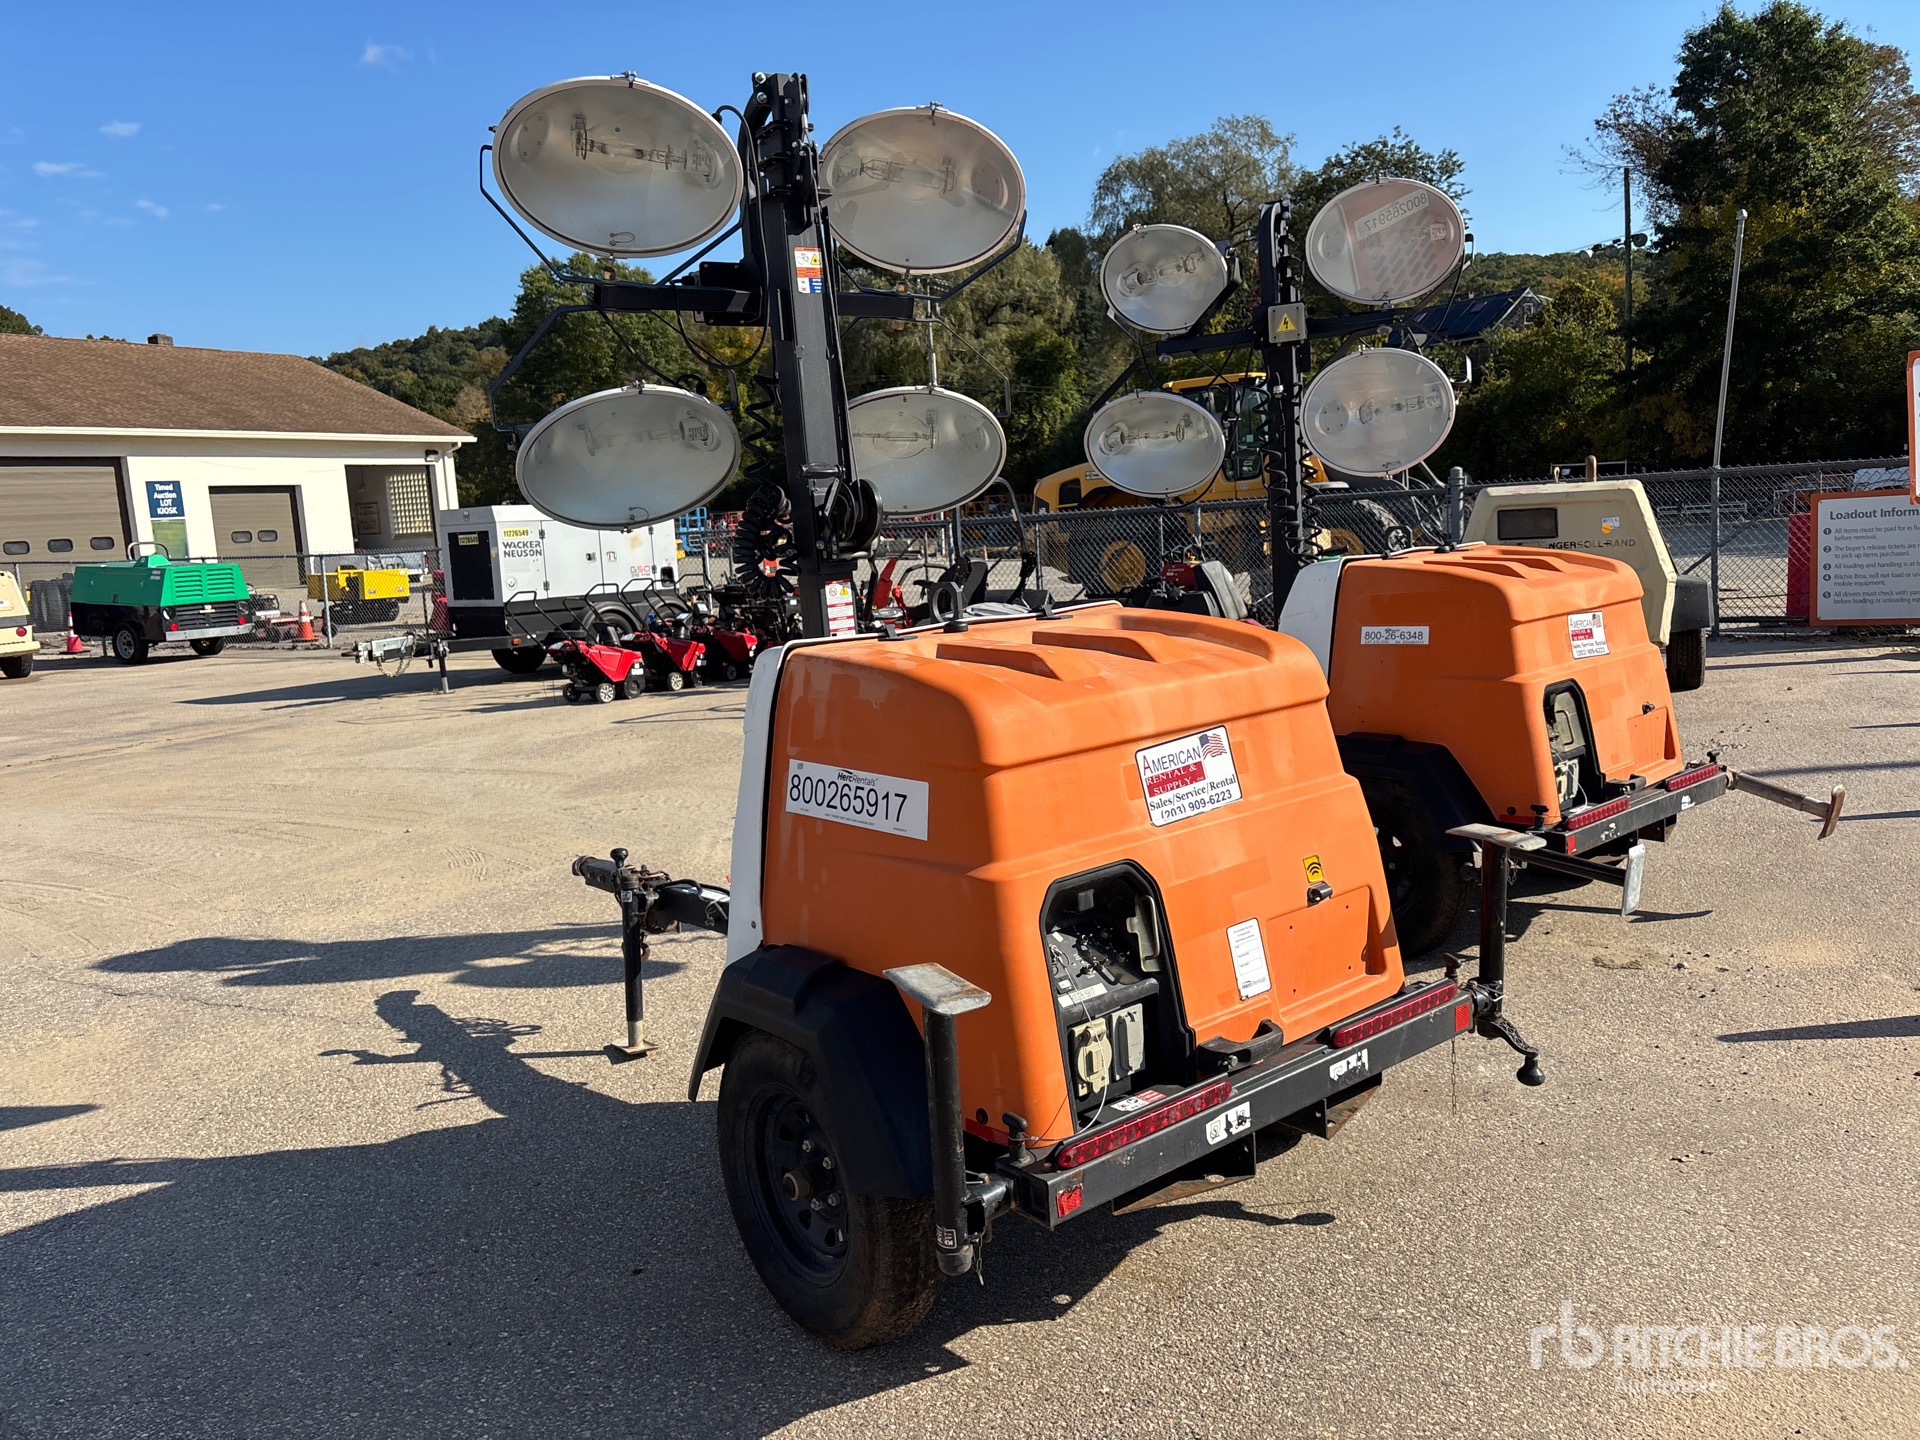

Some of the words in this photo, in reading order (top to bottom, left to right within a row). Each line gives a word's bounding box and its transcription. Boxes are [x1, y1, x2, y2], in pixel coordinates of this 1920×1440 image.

[1830, 509, 1877, 520] Loadout
[1880, 507, 1920, 517] Inform
[502, 540, 541, 549] WACKER
[504, 549, 542, 558] NEUSON
[1364, 630, 1424, 640] 800-26-6348
[1144, 746, 1202, 776] AMERICAN
[1146, 769, 1188, 786] RENTAL
[1189, 764, 1198, 772] &
[790, 774, 908, 822] 800265917
[1150, 774, 1237, 812] Sales/Service/Rental
[1160, 804, 1187, 820] (203)
[1189, 789, 1232, 812] 909-6223
